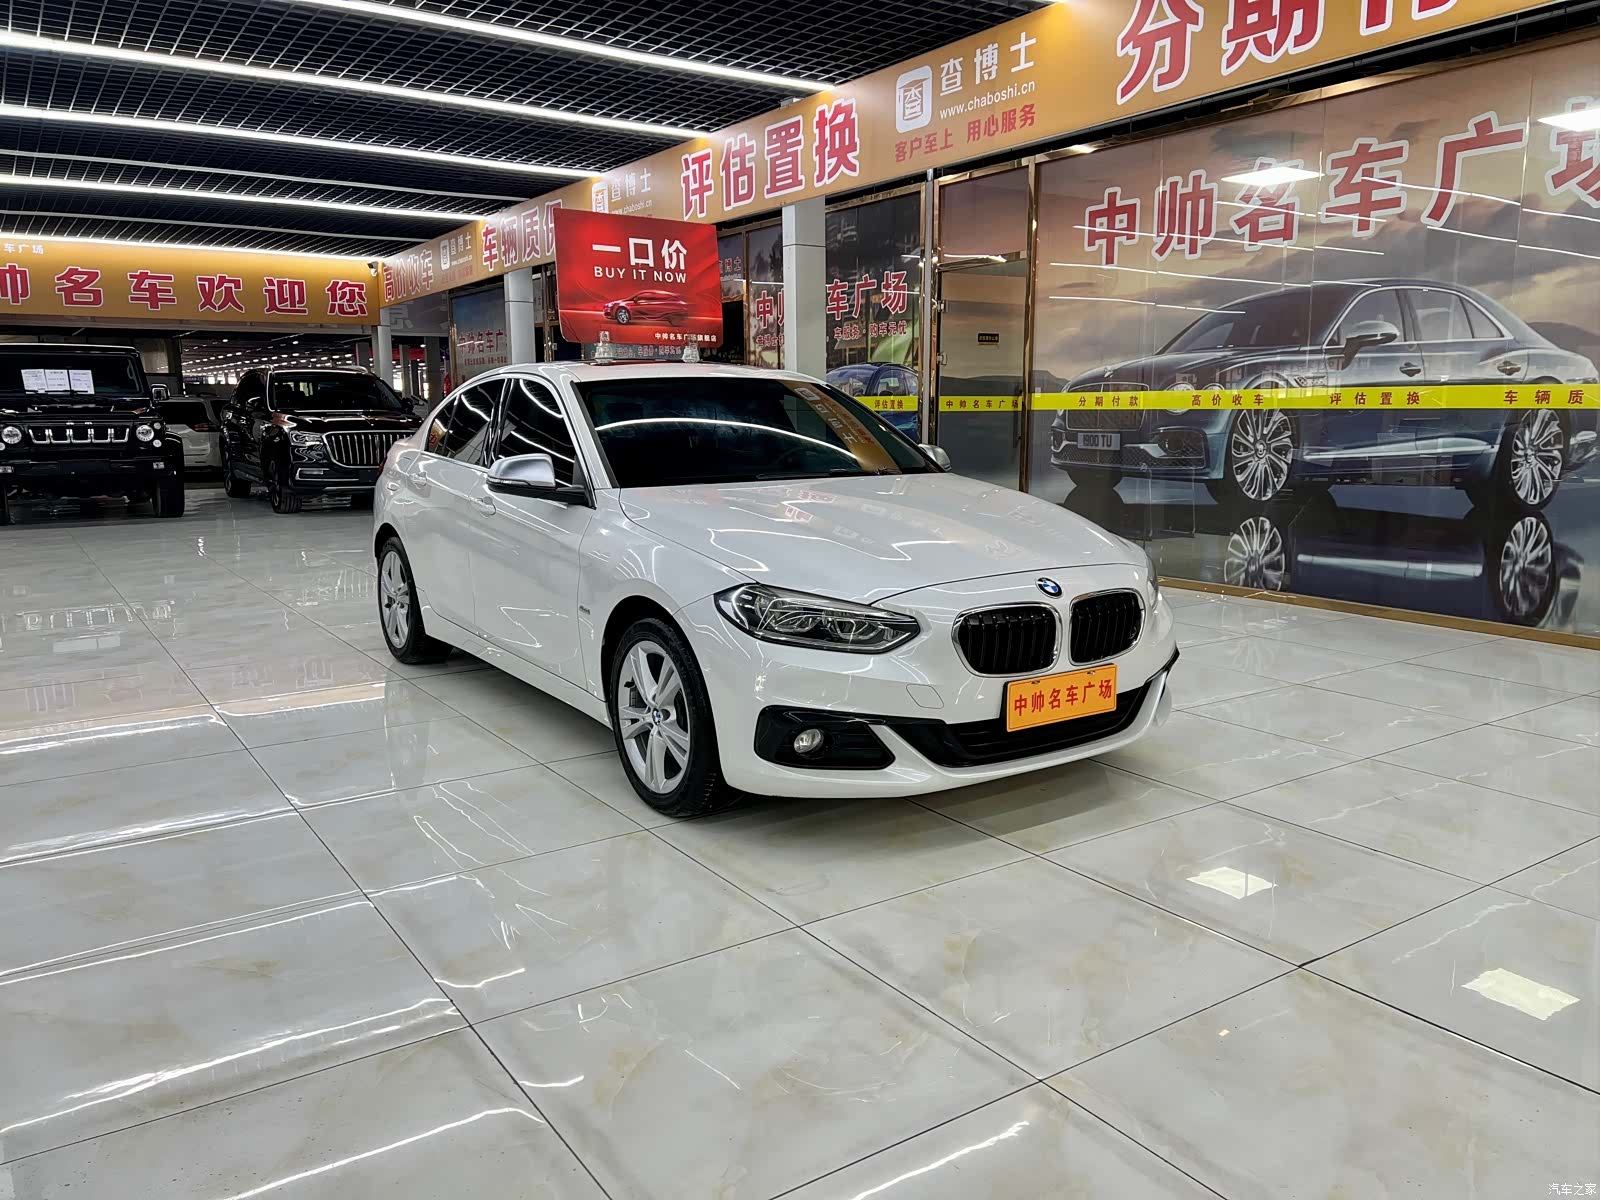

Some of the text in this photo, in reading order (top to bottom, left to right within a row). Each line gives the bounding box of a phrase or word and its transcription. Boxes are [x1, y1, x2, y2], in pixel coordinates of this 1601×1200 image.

[939, 31, 1037, 97] 查博士
[939, 80, 1036, 120] www.chaboshi.cn
[895, 103, 1036, 163] 客户至上 用心服务
[681, 97, 860, 221] 评估置换
[592, 237, 688, 270] 一口价
[593, 266, 687, 283] BUY IT NOW
[946, 400, 1019, 409] 中帅名车广场
[1078, 395, 1139, 407] 分期付款
[1192, 394, 1264, 407] 高价收车
[1329, 391, 1420, 406] 评估置换
[1503, 389, 1585, 405] 车辆质
[1013, 679, 1113, 717] 中帅名车广场
